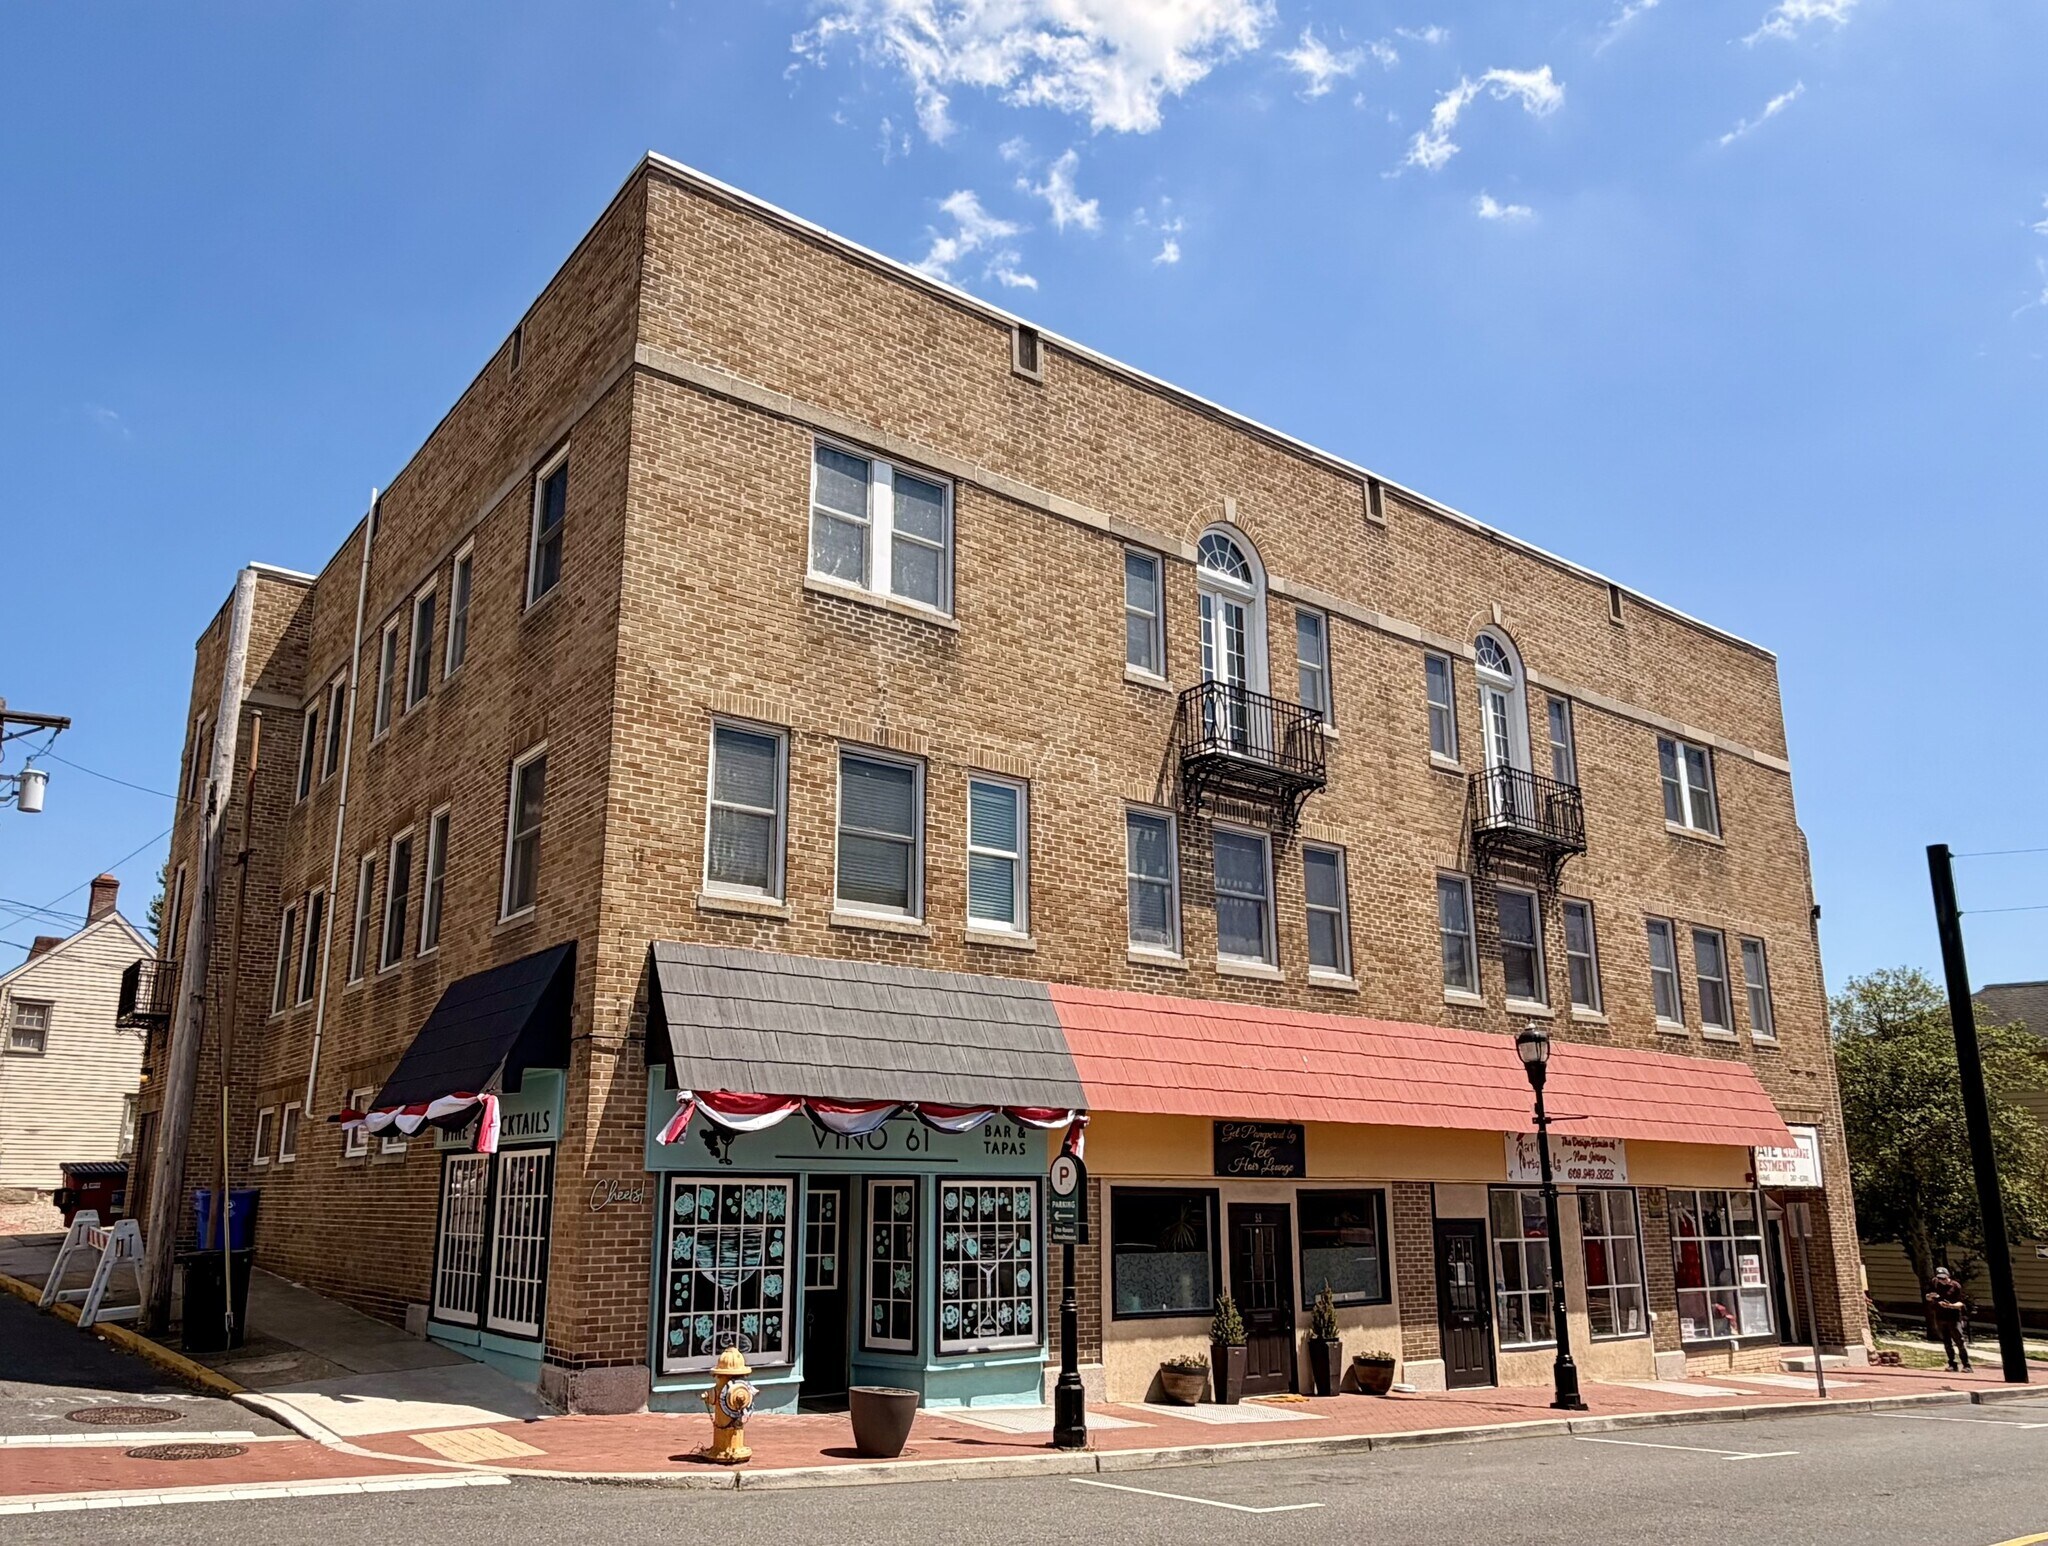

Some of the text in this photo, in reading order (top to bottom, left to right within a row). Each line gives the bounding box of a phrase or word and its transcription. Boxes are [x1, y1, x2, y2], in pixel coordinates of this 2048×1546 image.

[500, 1110, 550, 1137] CKTAILS
[811, 1124, 929, 1152] VINO 61
[984, 1124, 1026, 1139] BAR &
[1222, 1124, 1240, 1142] Get
[1287, 1129, 1297, 1144] by
[983, 1141, 1026, 1155] TAPAS
[1561, 1137, 1571, 1147] The
[1573, 1150, 1588, 1163] New
[1757, 1146, 1778, 1158] ATE
[1228, 1157, 1294, 1176] Hair Lounge
[1758, 1160, 1796, 1172] ESTMENTS
[1060, 1166, 1070, 1186] P
[1052, 1200, 1076, 1209] PARKING
